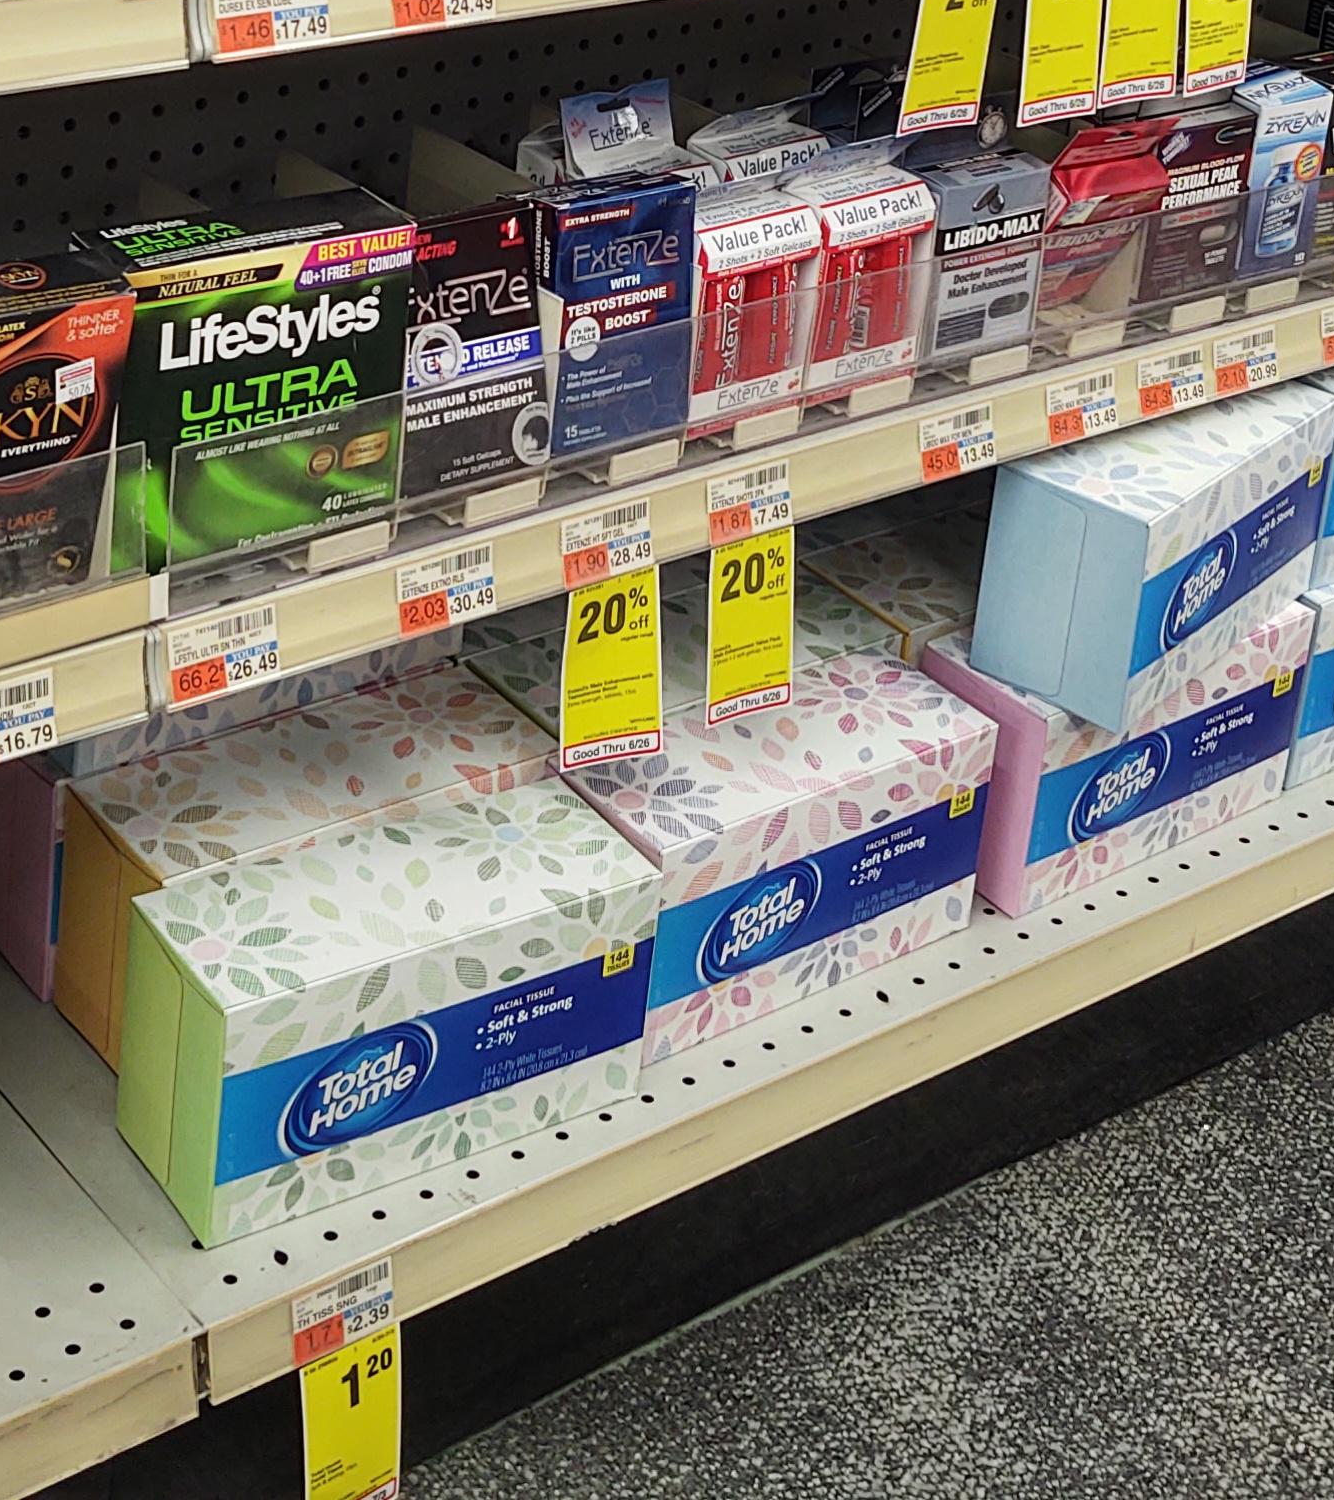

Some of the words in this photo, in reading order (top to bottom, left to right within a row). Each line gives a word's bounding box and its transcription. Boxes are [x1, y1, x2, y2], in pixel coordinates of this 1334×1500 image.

[907, 112, 926, 126] Good
[928, 111, 948, 124] Thru
[951, 108, 968, 121] 6/26
[1162, 181, 1242, 210] PERFORMANCE
[318, 242, 357, 260] BEST
[363, 232, 411, 254] VALUE!
[712, 228, 759, 253] Value
[762, 215, 808, 242] Pack!
[945, 214, 1041, 251] LIBIDO-MAX
[158, 276, 219, 299] NATURAL
[223, 268, 258, 288] FEEL
[611, 274, 641, 289] WITH
[953, 266, 981, 284] Doctor
[984, 259, 1028, 277] Developed
[568, 286, 667, 317] TESTOSTERONE
[159, 295, 380, 371] LifeStyles
[605, 311, 651, 330] BOOST
[472, 335, 530, 361] RELEASE
[180, 359, 357, 422] ULTRA
[406, 395, 465, 417] MAXIMUM
[469, 378, 533, 403] STRENGTH
[449, 587, 494, 615] $30.49
[578, 586, 648, 644] 20%
[227, 652, 277, 680] $26.49
[489, 1009, 517, 1034] Soft
[519, 1008, 529, 1023] &
[533, 994, 573, 1019] Strong
[319, 1044, 403, 1103] Total
[309, 1062, 417, 1139] Home
[347, 1303, 390, 1336] $2.39
